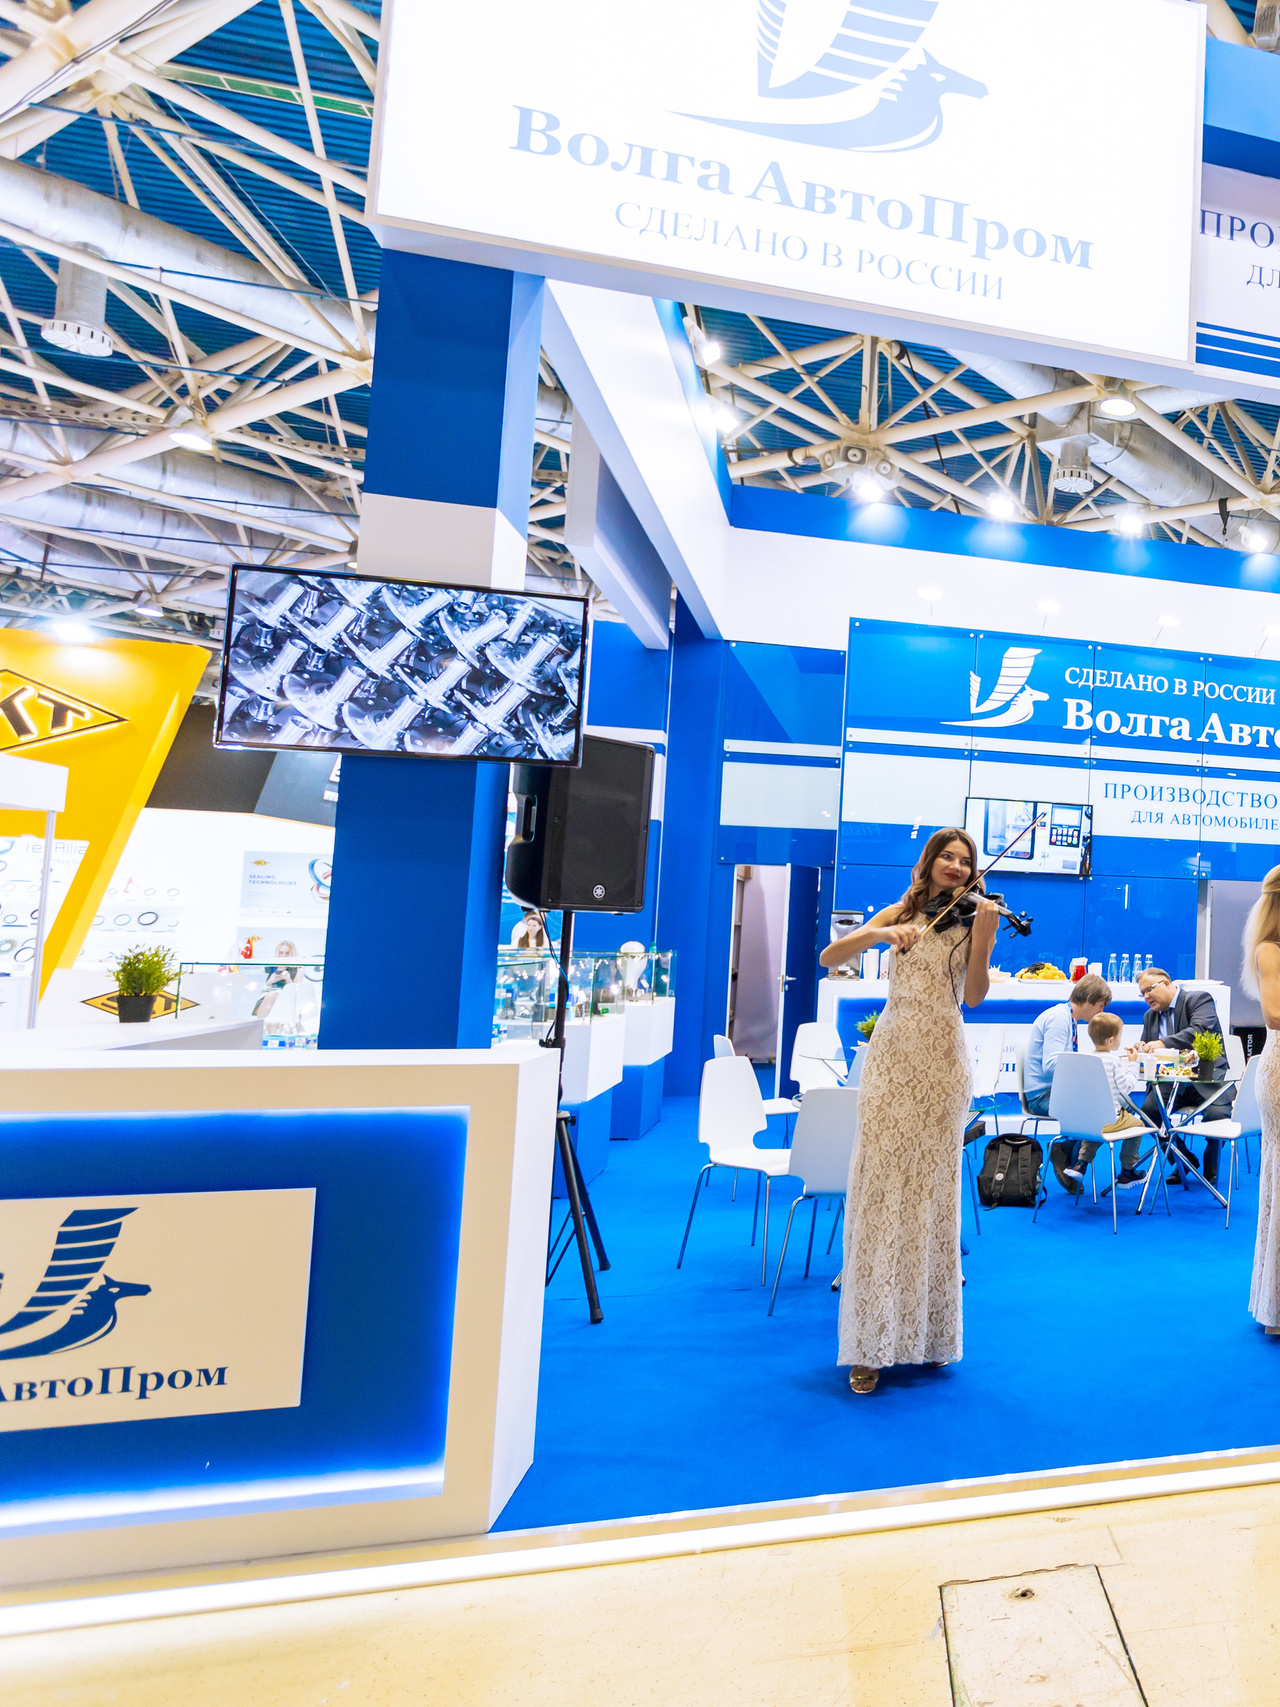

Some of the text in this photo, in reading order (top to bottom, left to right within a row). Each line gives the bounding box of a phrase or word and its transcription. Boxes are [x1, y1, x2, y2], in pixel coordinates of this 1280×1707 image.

[509, 105, 1094, 270] Волга АвтоПром
[614, 201, 1004, 301] СДЕЛАНО В РОССИИ
[1064, 666, 1276, 705] СДЕЛАНО В РОССИИ
[1062, 697, 1191, 741] Волга
[1103, 782, 1278, 811] ПРОИЗВОДСТВО
[1131, 810, 1165, 825] ДЛЯ
